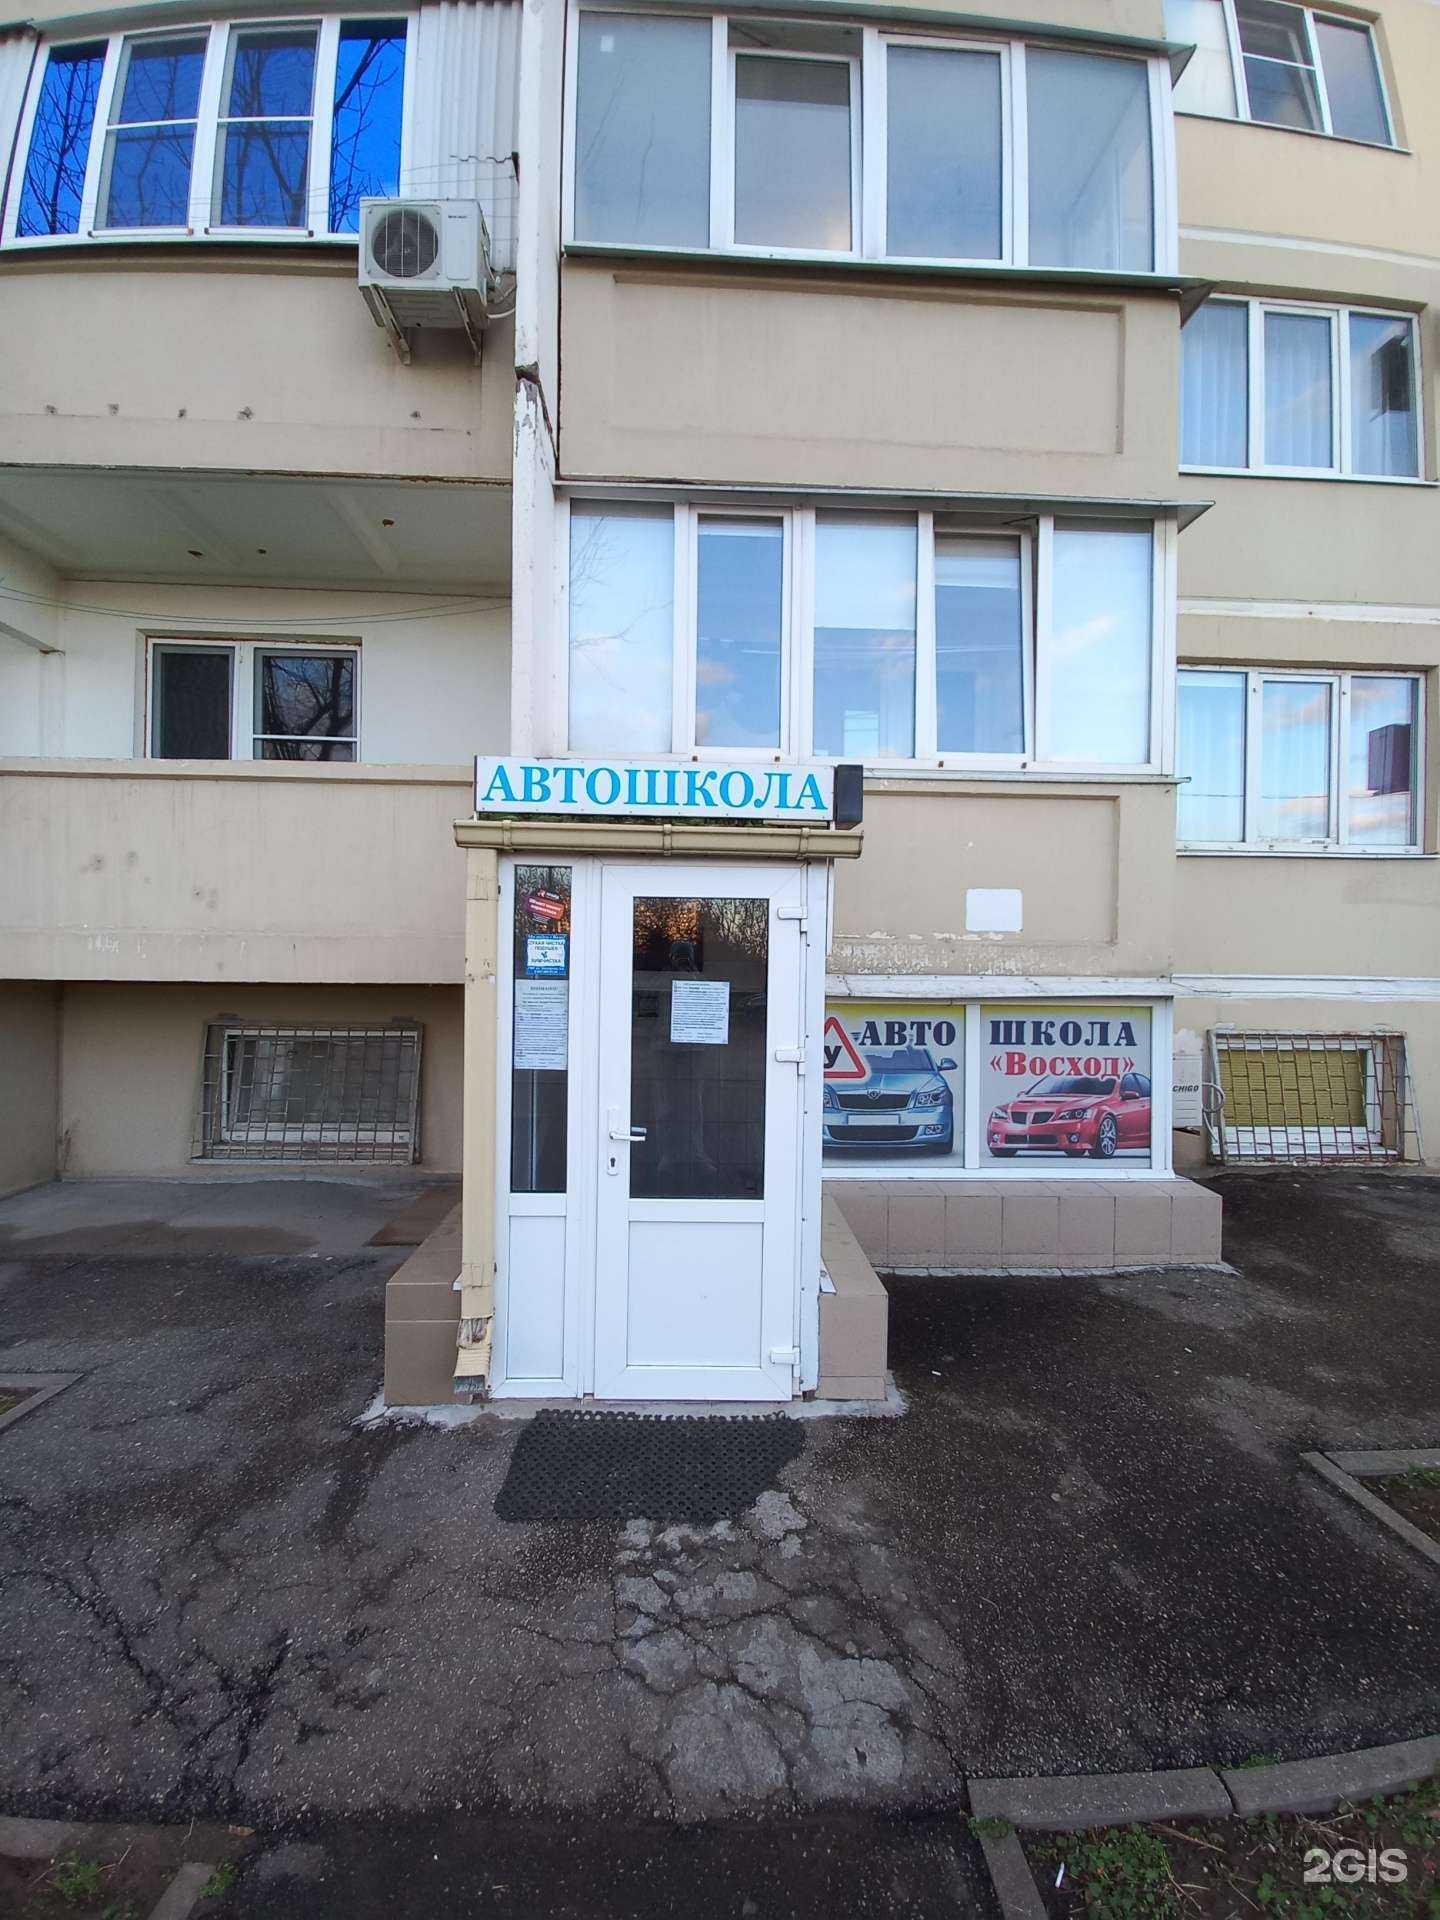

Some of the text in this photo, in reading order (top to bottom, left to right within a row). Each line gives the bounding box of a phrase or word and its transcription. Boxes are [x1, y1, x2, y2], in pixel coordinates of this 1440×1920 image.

[480, 764, 828, 811] АВТОШКОЛА
[859, 1020, 956, 1047] АВТО
[989, 1020, 1138, 1047] ШКОЛА
[990, 1052, 1136, 1080] «Восход»
[1172, 1084, 1199, 1093] CHIGO
